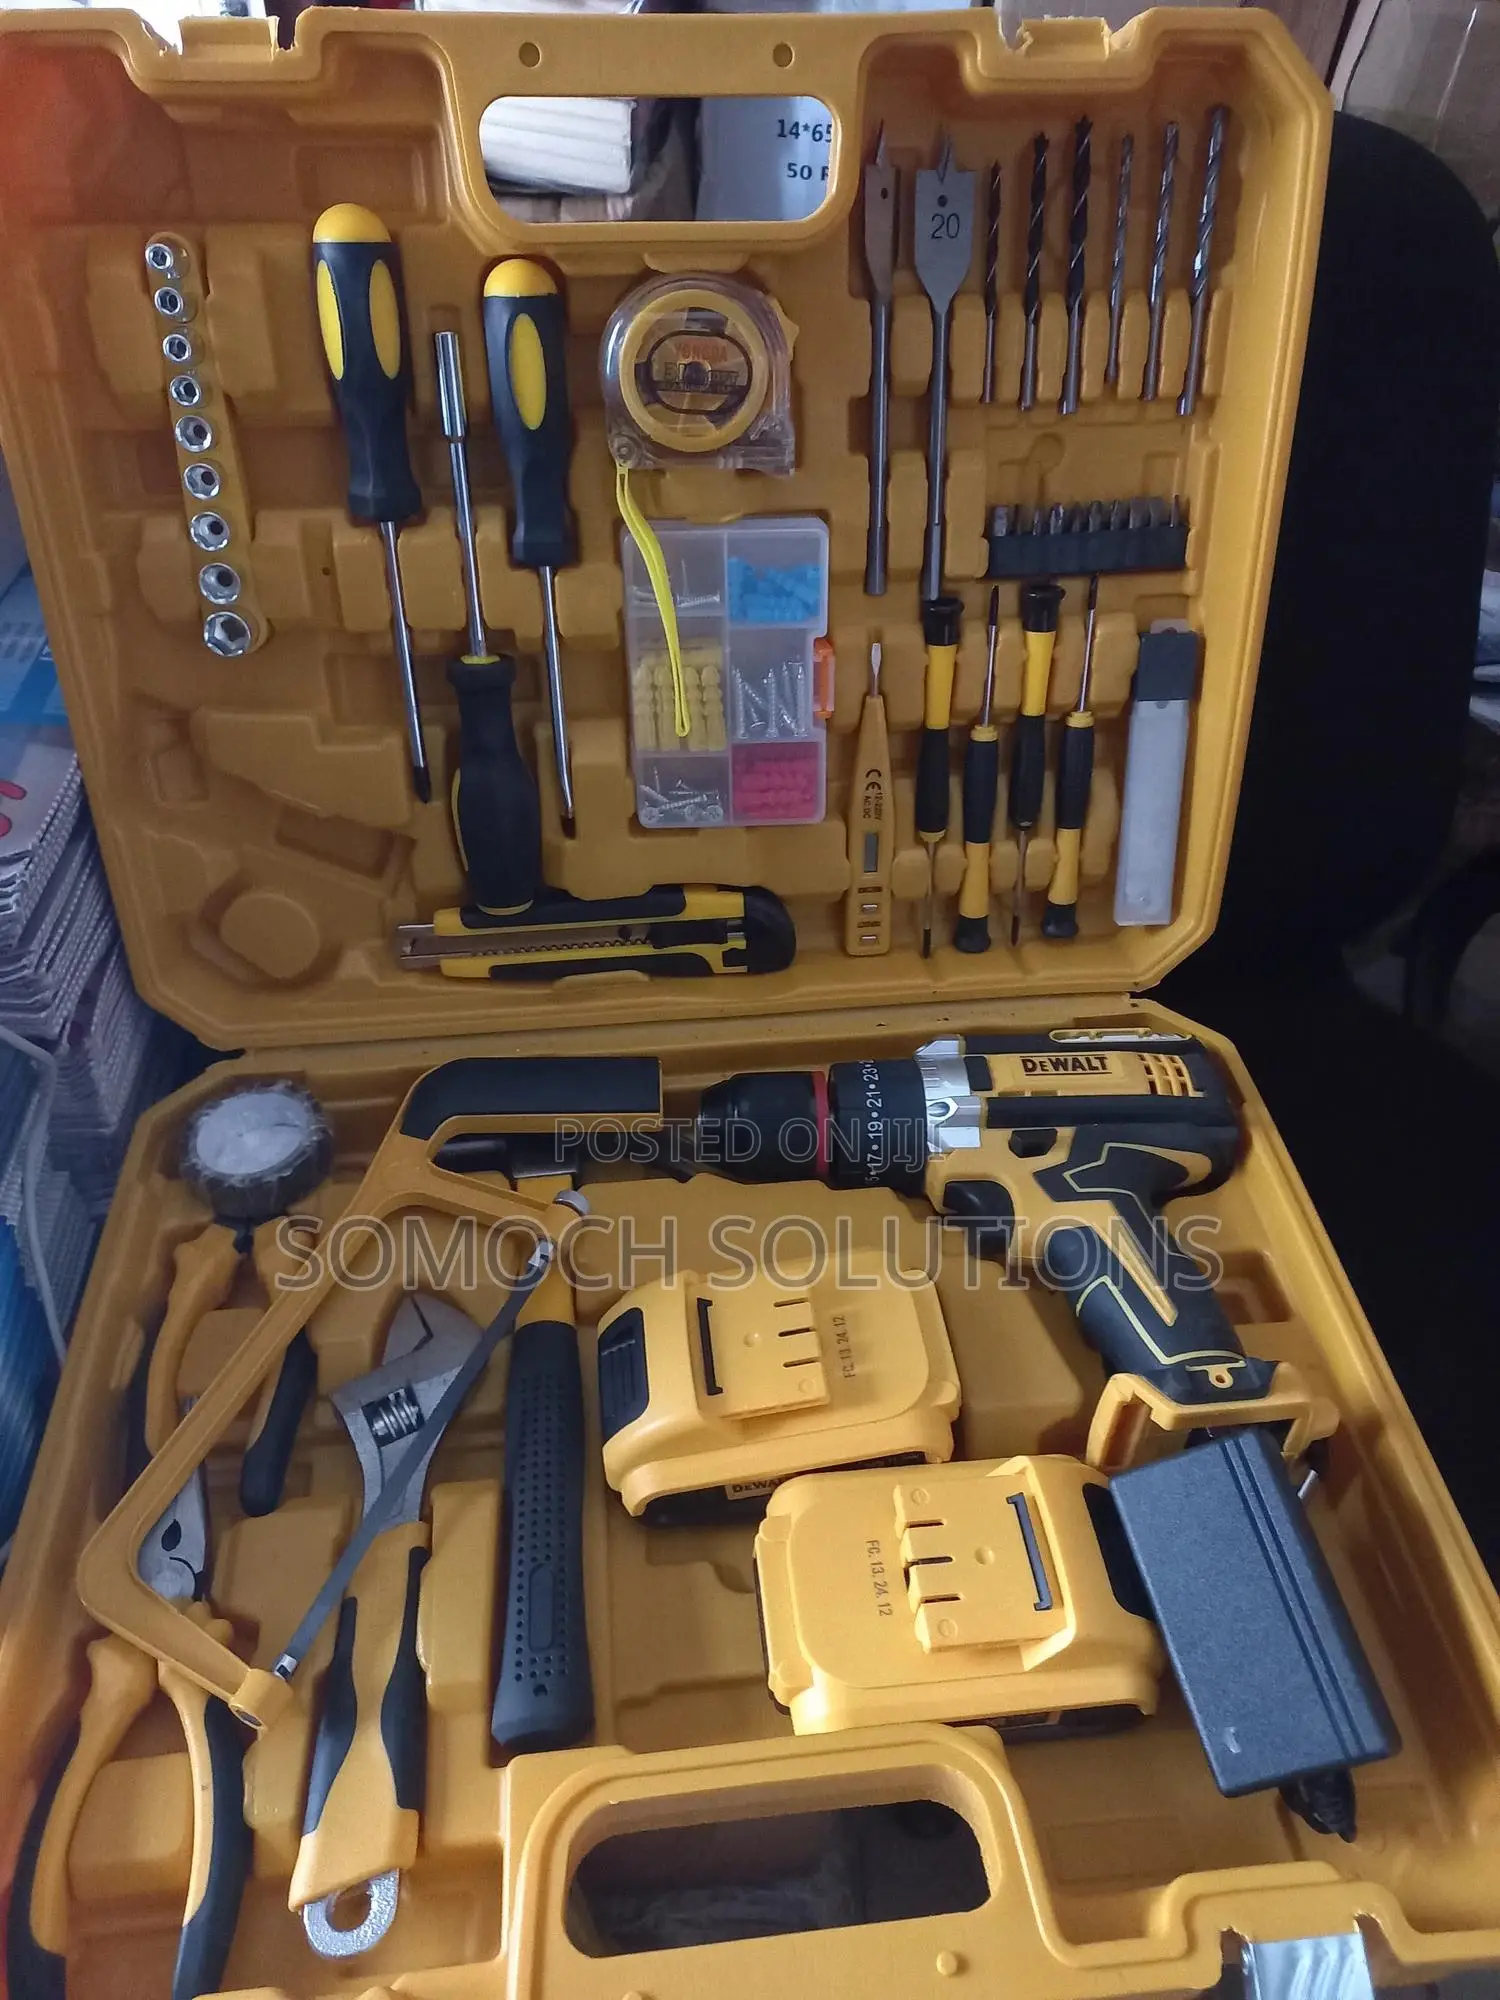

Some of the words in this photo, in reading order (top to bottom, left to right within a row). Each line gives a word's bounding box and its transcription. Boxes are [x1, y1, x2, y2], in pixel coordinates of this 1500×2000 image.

[787, 162, 813, 180] 50
[931, 213, 959, 239] 20
[862, 1067, 879, 1081] 23
[866, 1091, 882, 1108] 21
[867, 1120, 884, 1139] 19
[867, 1153, 882, 1167] 17
